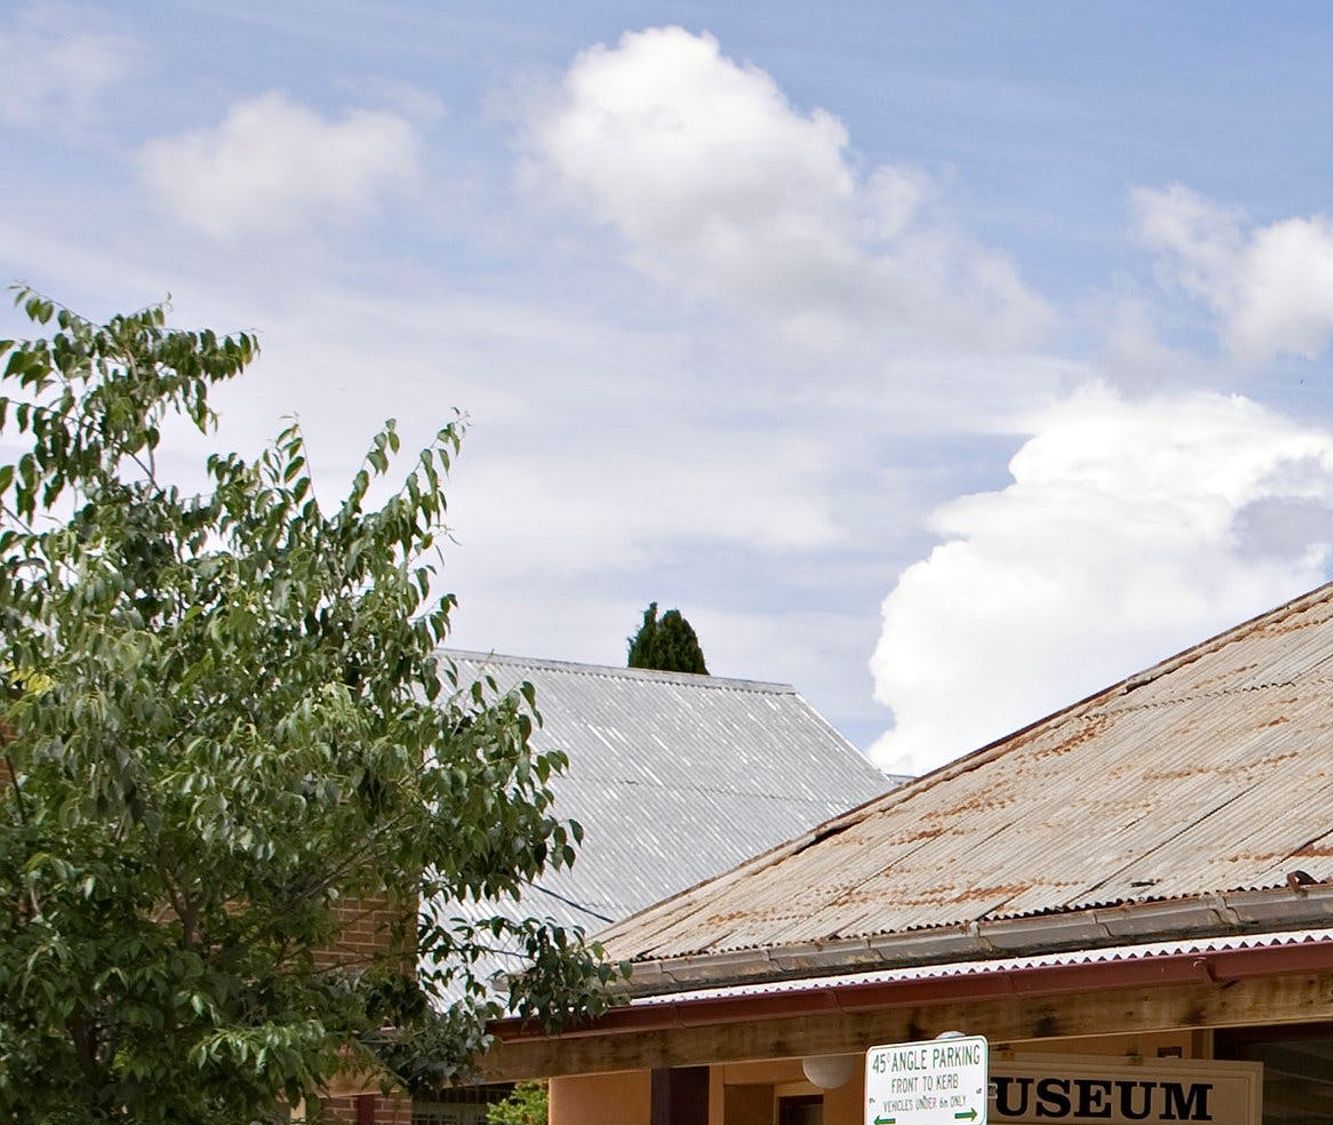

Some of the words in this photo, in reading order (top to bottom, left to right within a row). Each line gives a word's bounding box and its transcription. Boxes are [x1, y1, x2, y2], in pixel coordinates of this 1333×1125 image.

[891, 1050, 927, 1072] ANGLE
[933, 1044, 980, 1069] PARKING
[891, 1077, 918, 1094] FRONT
[923, 1076, 933, 1091] TO
[936, 1073, 958, 1090] KERB
[883, 1099, 914, 1113] VEHICLES
[950, 1095, 966, 1108] ONLY
[989, 1076, 1213, 1121] USEUM
